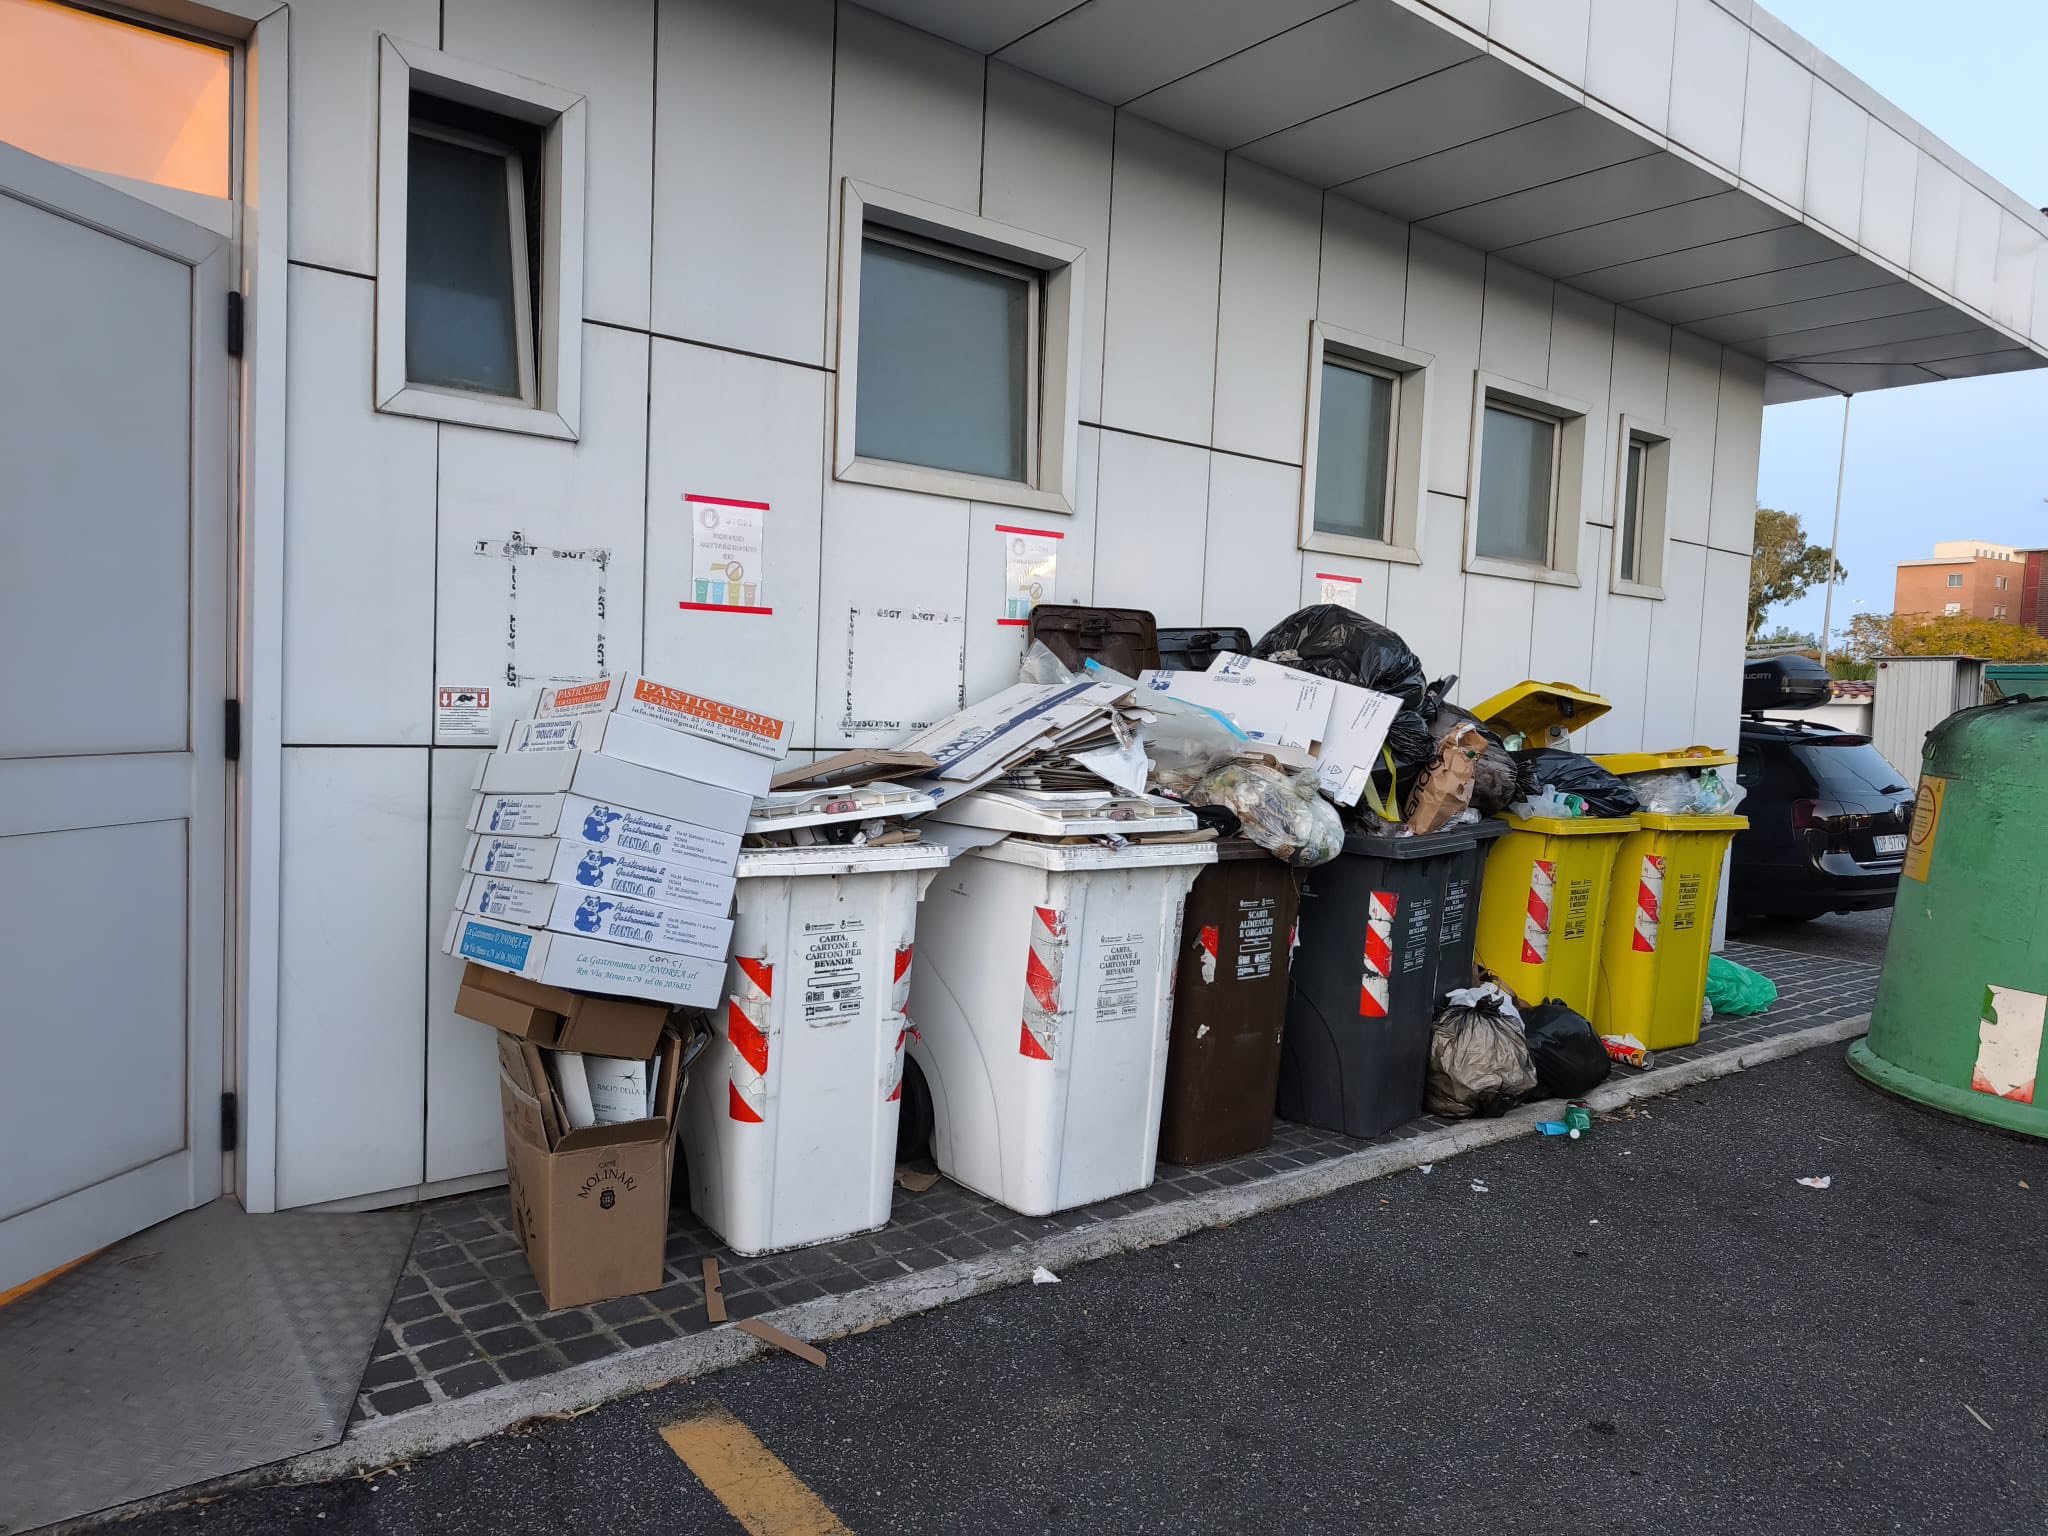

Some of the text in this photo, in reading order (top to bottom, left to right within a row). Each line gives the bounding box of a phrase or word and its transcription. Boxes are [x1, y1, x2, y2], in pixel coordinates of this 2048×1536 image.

[558, 683, 608, 699] PASTICCERIA
[643, 682, 778, 730] PASTICCERIA
[643, 702, 655, 711] Via
[639, 693, 777, 738] CORNETTI SPECIALI
[622, 813, 664, 831] Pasticceria
[621, 823, 668, 841] Gastronomia
[616, 857, 657, 875] Pasticceria
[615, 867, 663, 884] Gastronomia
[614, 901, 655, 919] Pasticceria
[613, 912, 660, 928] Gastronomia
[819, 934, 848, 944] CARTA,
[1245, 927, 1272, 937] ORGANICI
[805, 948, 862, 961] CARTONI PER
[810, 940, 858, 953] CARTONE E
[576, 953, 587, 963] La
[589, 956, 636, 971] Gastronomia
[814, 957, 853, 968] BEVANDE
[577, 1168, 638, 1199] MOLINARI
